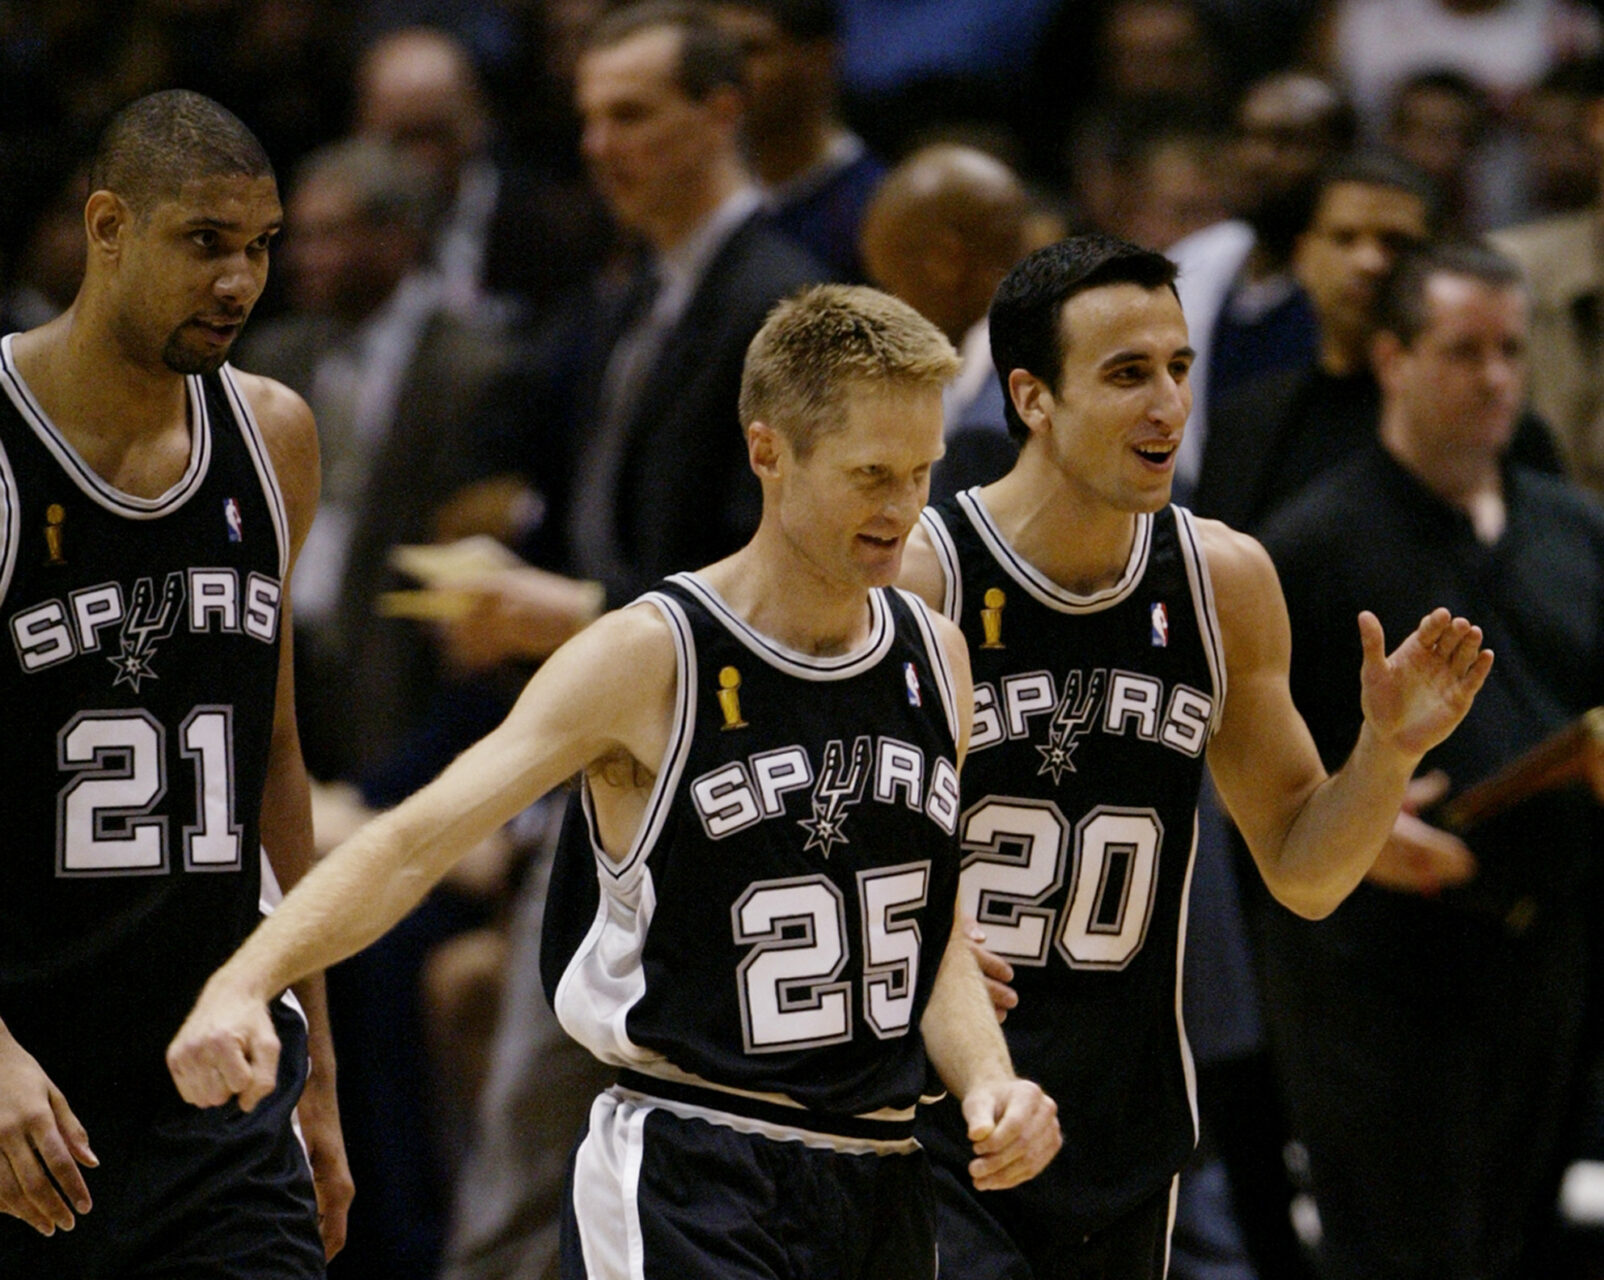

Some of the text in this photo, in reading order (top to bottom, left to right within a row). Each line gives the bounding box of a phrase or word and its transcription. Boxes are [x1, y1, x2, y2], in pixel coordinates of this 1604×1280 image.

[10, 567, 281, 690] SPURS
[55, 704, 248, 877] 21
[690, 736, 960, 856] SPURS
[967, 669, 1213, 783] SPURS
[731, 860, 931, 1054] 25
[960, 795, 1164, 971] 20
